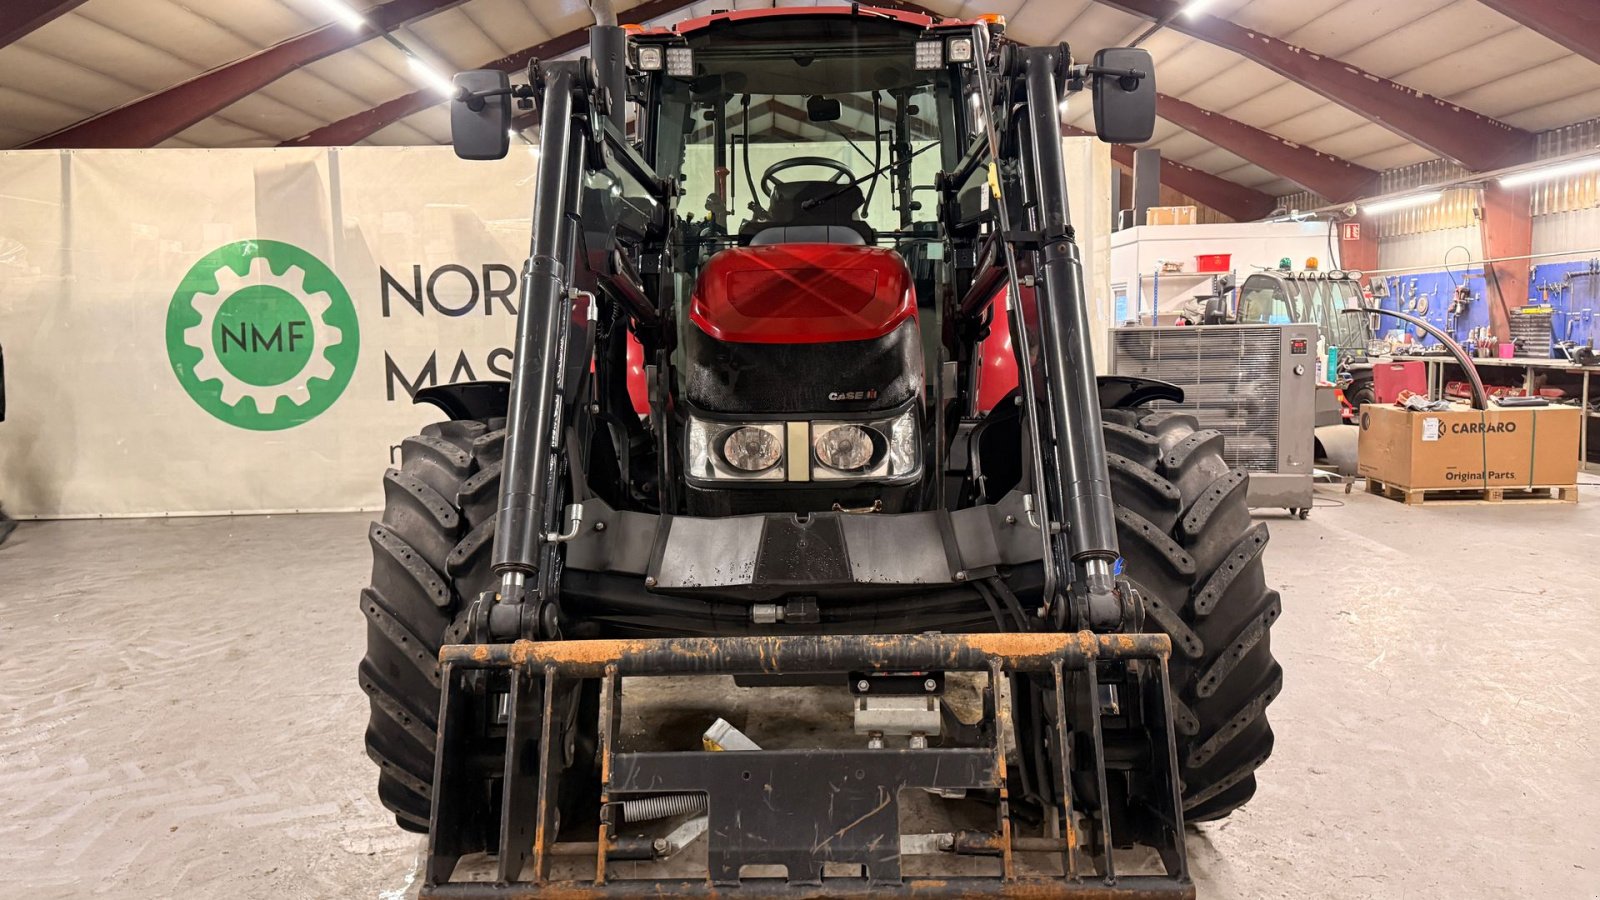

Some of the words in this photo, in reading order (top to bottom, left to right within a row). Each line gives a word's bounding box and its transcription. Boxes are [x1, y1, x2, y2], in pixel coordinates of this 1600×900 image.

[221, 321, 306, 353] NMF
[828, 391, 863, 400] CASE
[1451, 421, 1516, 434] CARRARO
[1445, 471, 1486, 482] Original
